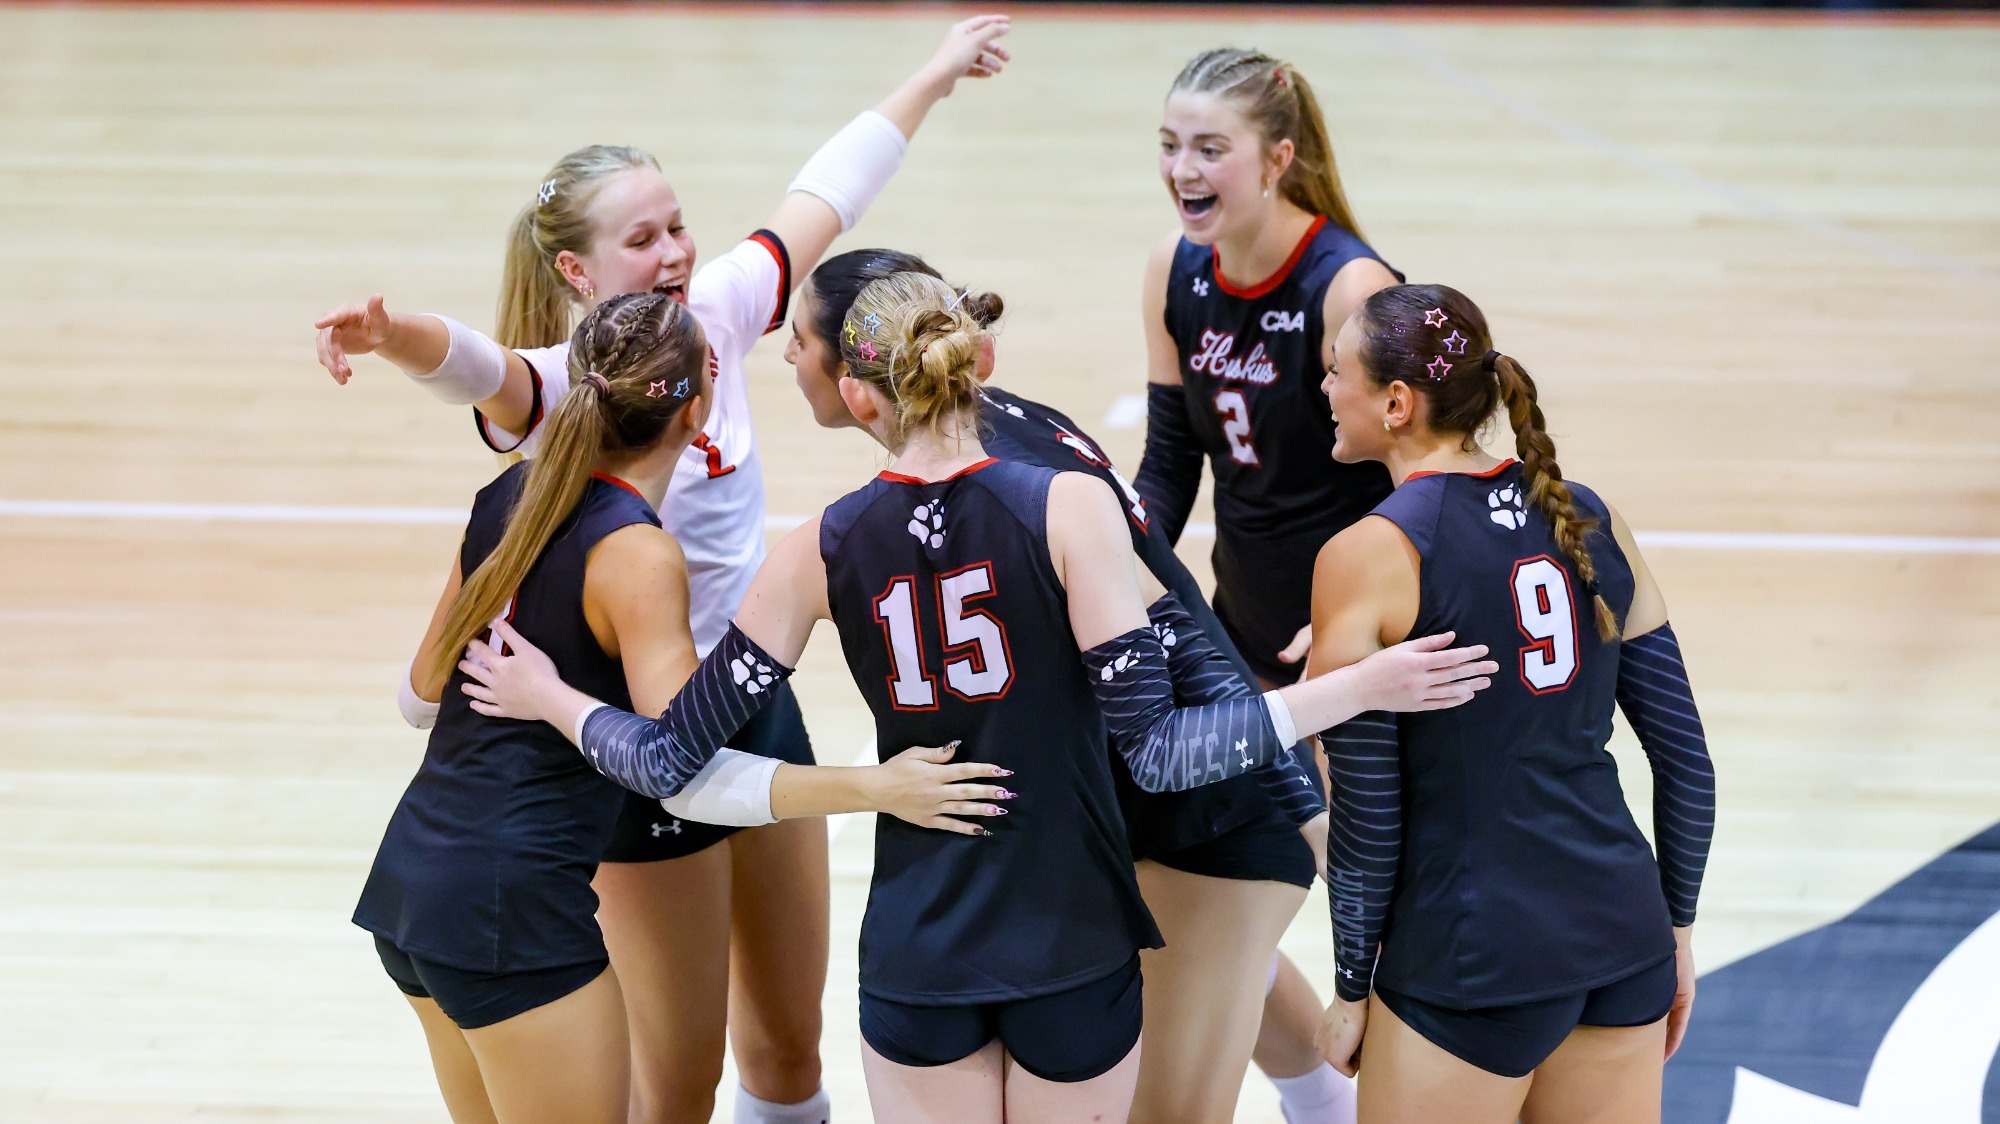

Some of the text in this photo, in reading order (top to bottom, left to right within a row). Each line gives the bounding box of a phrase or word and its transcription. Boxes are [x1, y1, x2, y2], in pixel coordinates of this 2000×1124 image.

[1260, 310, 1305, 332] CAA
[1212, 387, 1262, 468] 2
[872, 560, 1016, 711] 15
[1510, 553, 1580, 695] 9
